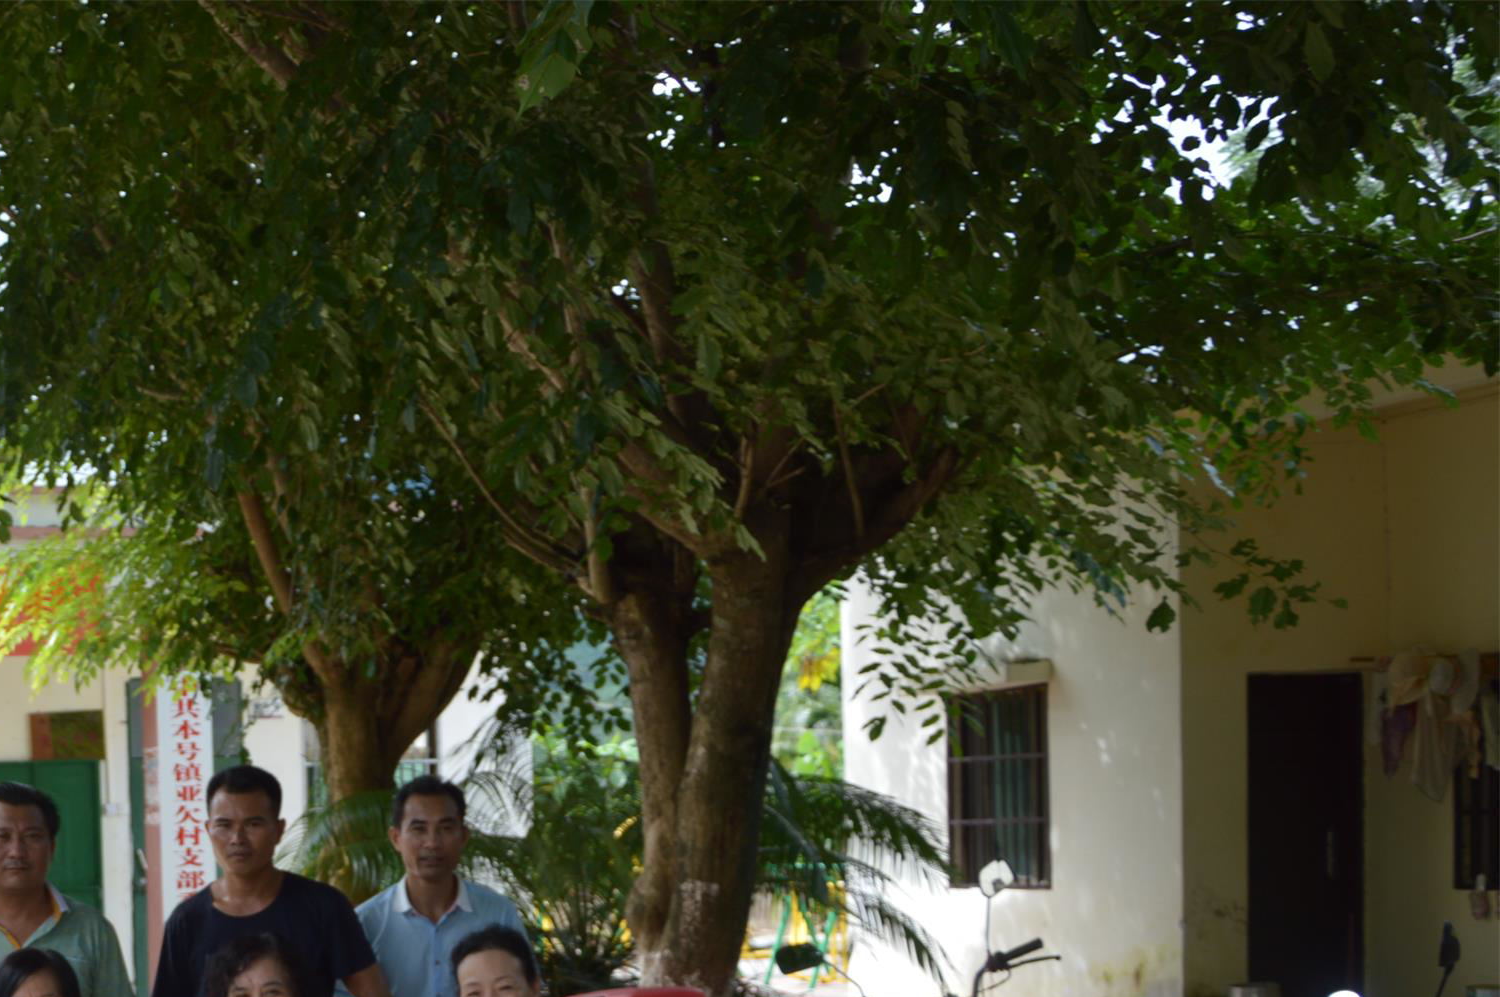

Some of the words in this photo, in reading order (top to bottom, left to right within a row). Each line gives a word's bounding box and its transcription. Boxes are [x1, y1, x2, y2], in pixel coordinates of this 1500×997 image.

[173, 677, 205, 901] 共本号镇亚欠村支部
